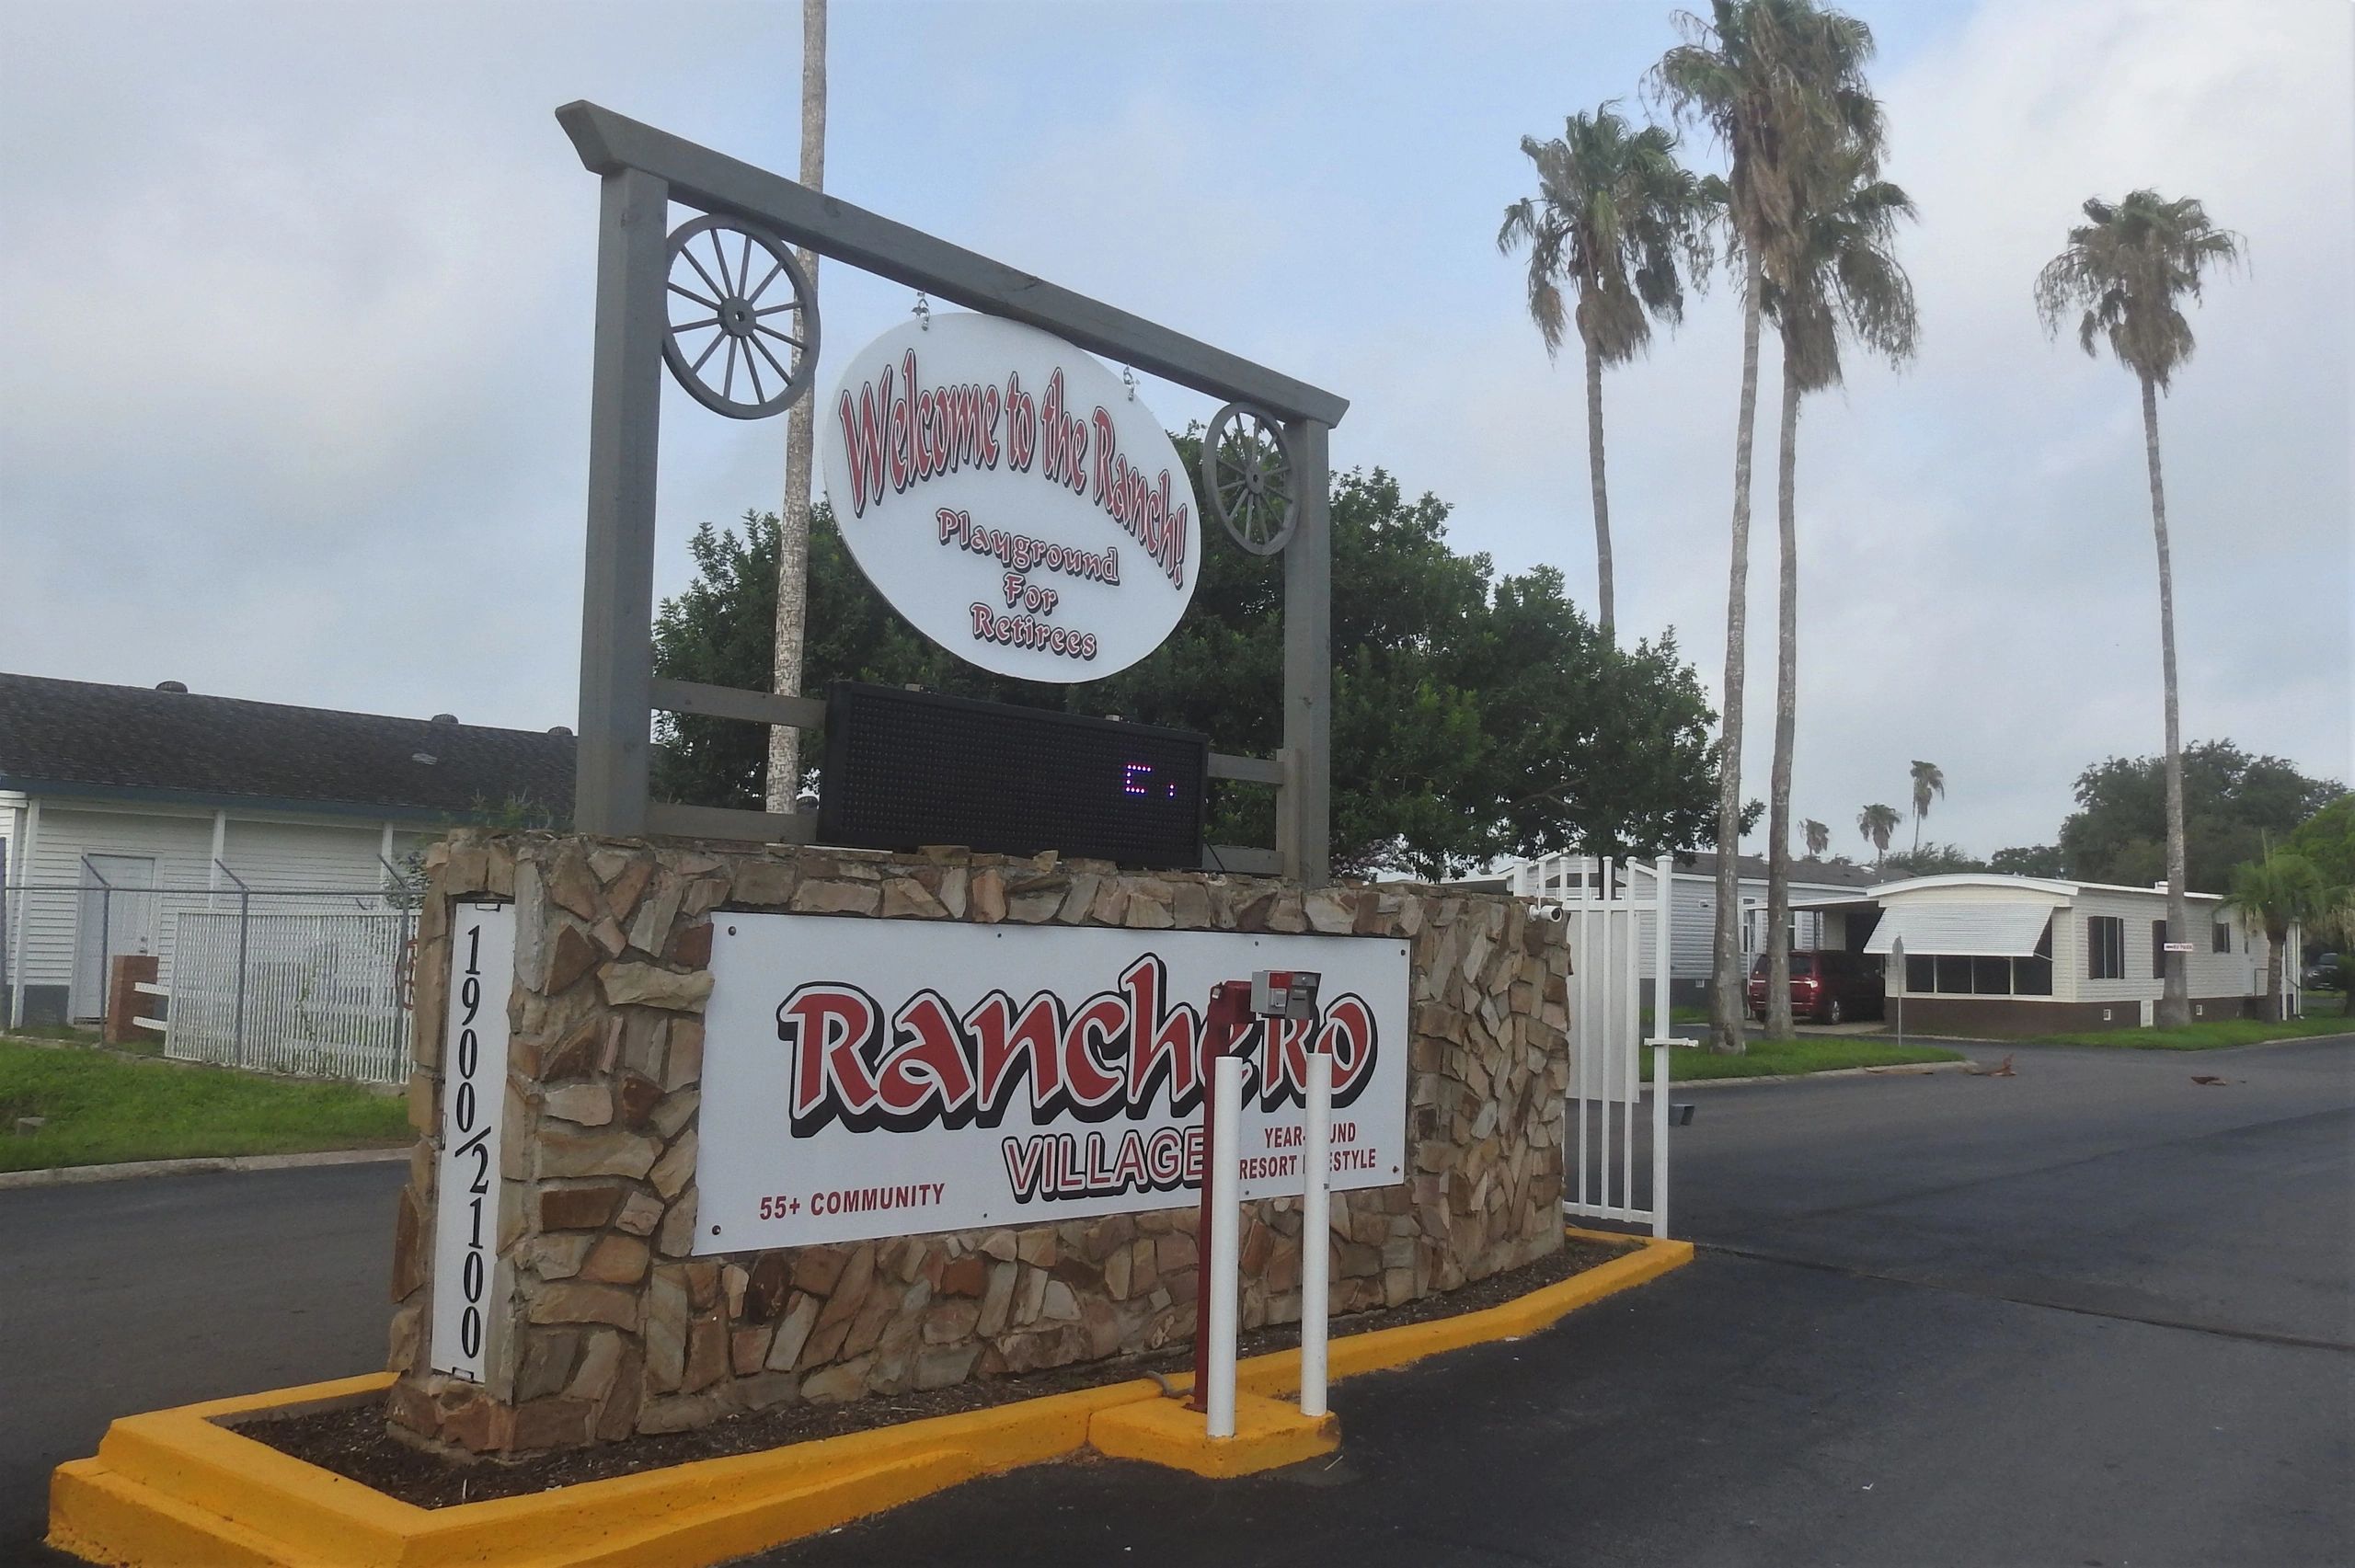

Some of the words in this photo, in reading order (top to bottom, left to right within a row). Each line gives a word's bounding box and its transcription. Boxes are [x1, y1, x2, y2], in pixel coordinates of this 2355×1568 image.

[839, 348, 1000, 518] Welcome
[1005, 370, 1034, 473] to
[1040, 367, 1088, 494] the
[1092, 406, 1188, 589] Ranch!
[936, 508, 1120, 585] Playground
[1003, 573, 1059, 614] For
[970, 602, 1097, 661] Retirees
[454, 924, 492, 1359] 1900/2100
[1002, 1126, 1205, 1205] VILLAGE
[1239, 1155, 1298, 1180] RESORT
[759, 1196, 800, 1220] 55+
[810, 1183, 946, 1216] COMMUNITY
